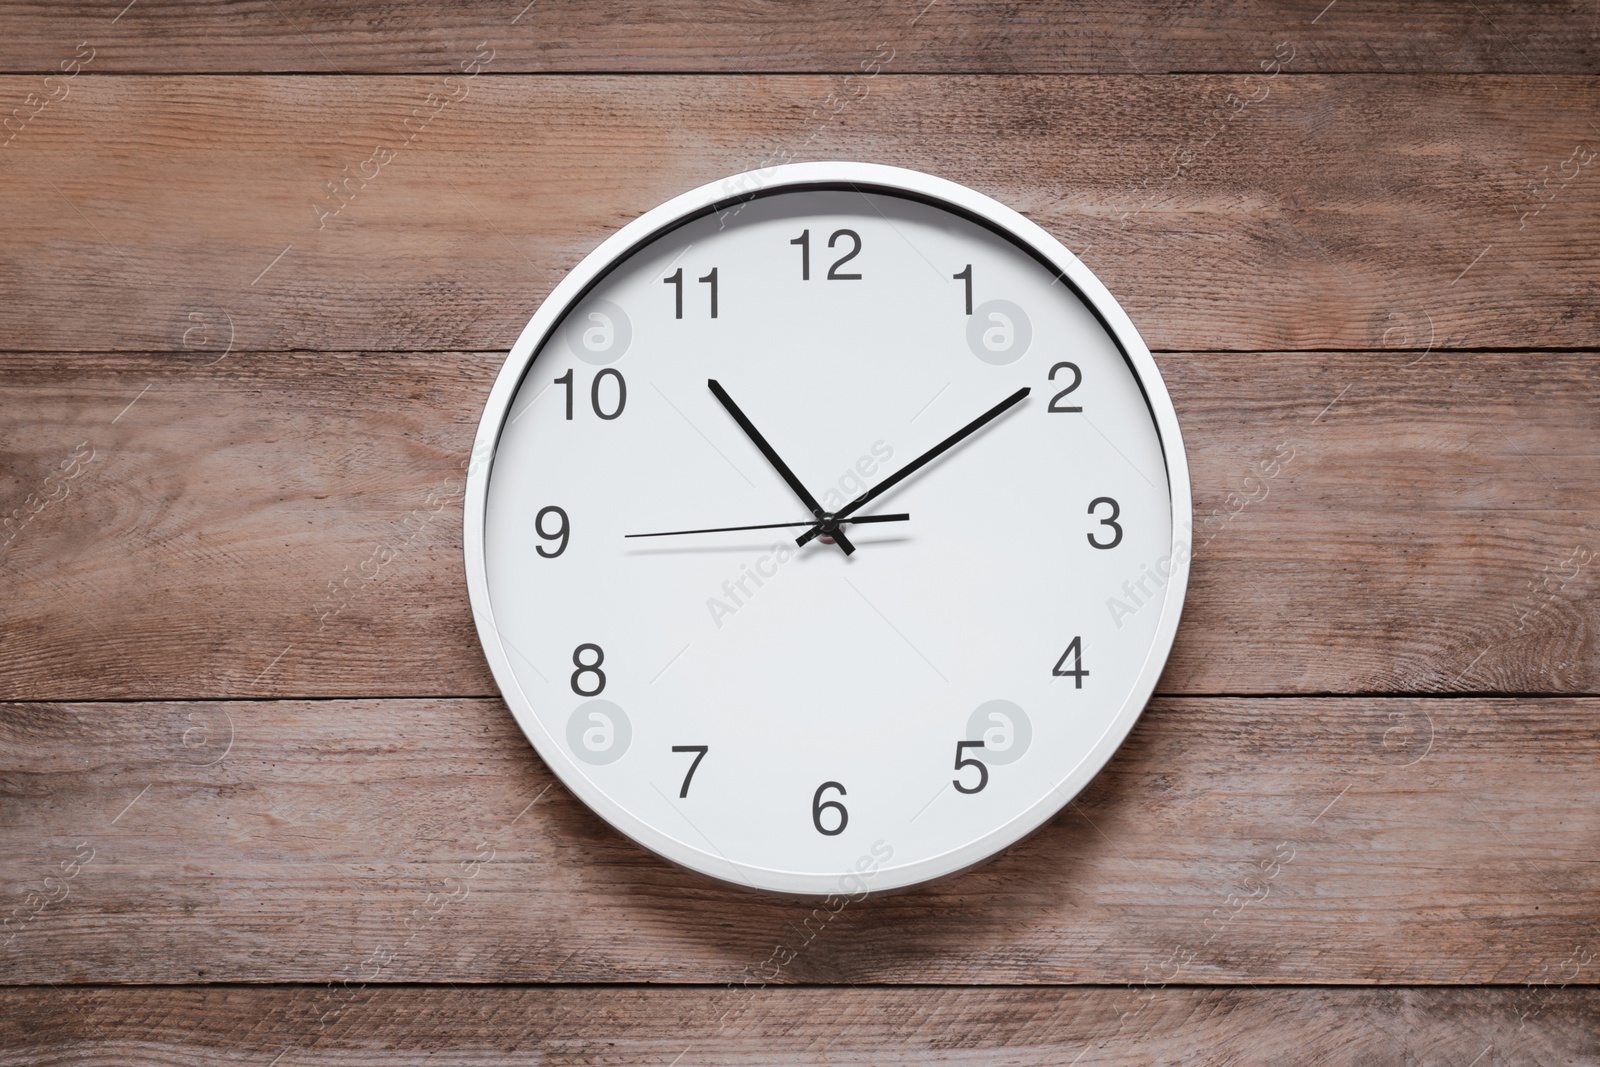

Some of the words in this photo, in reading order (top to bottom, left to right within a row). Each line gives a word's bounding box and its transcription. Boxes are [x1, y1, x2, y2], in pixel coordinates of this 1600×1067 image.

[790, 229, 862, 281] 12
[663, 267, 718, 320] 11
[953, 264, 973, 316] 1
[553, 367, 627, 421] 10
[1047, 361, 1083, 413] 2
[534, 505, 570, 559] 9
[1086, 496, 1123, 550] 3
[570, 643, 607, 697] 8
[1052, 636, 1090, 689] 4
[671, 745, 709, 799] 7
[952, 740, 989, 795] 5
[812, 781, 849, 836] 6
